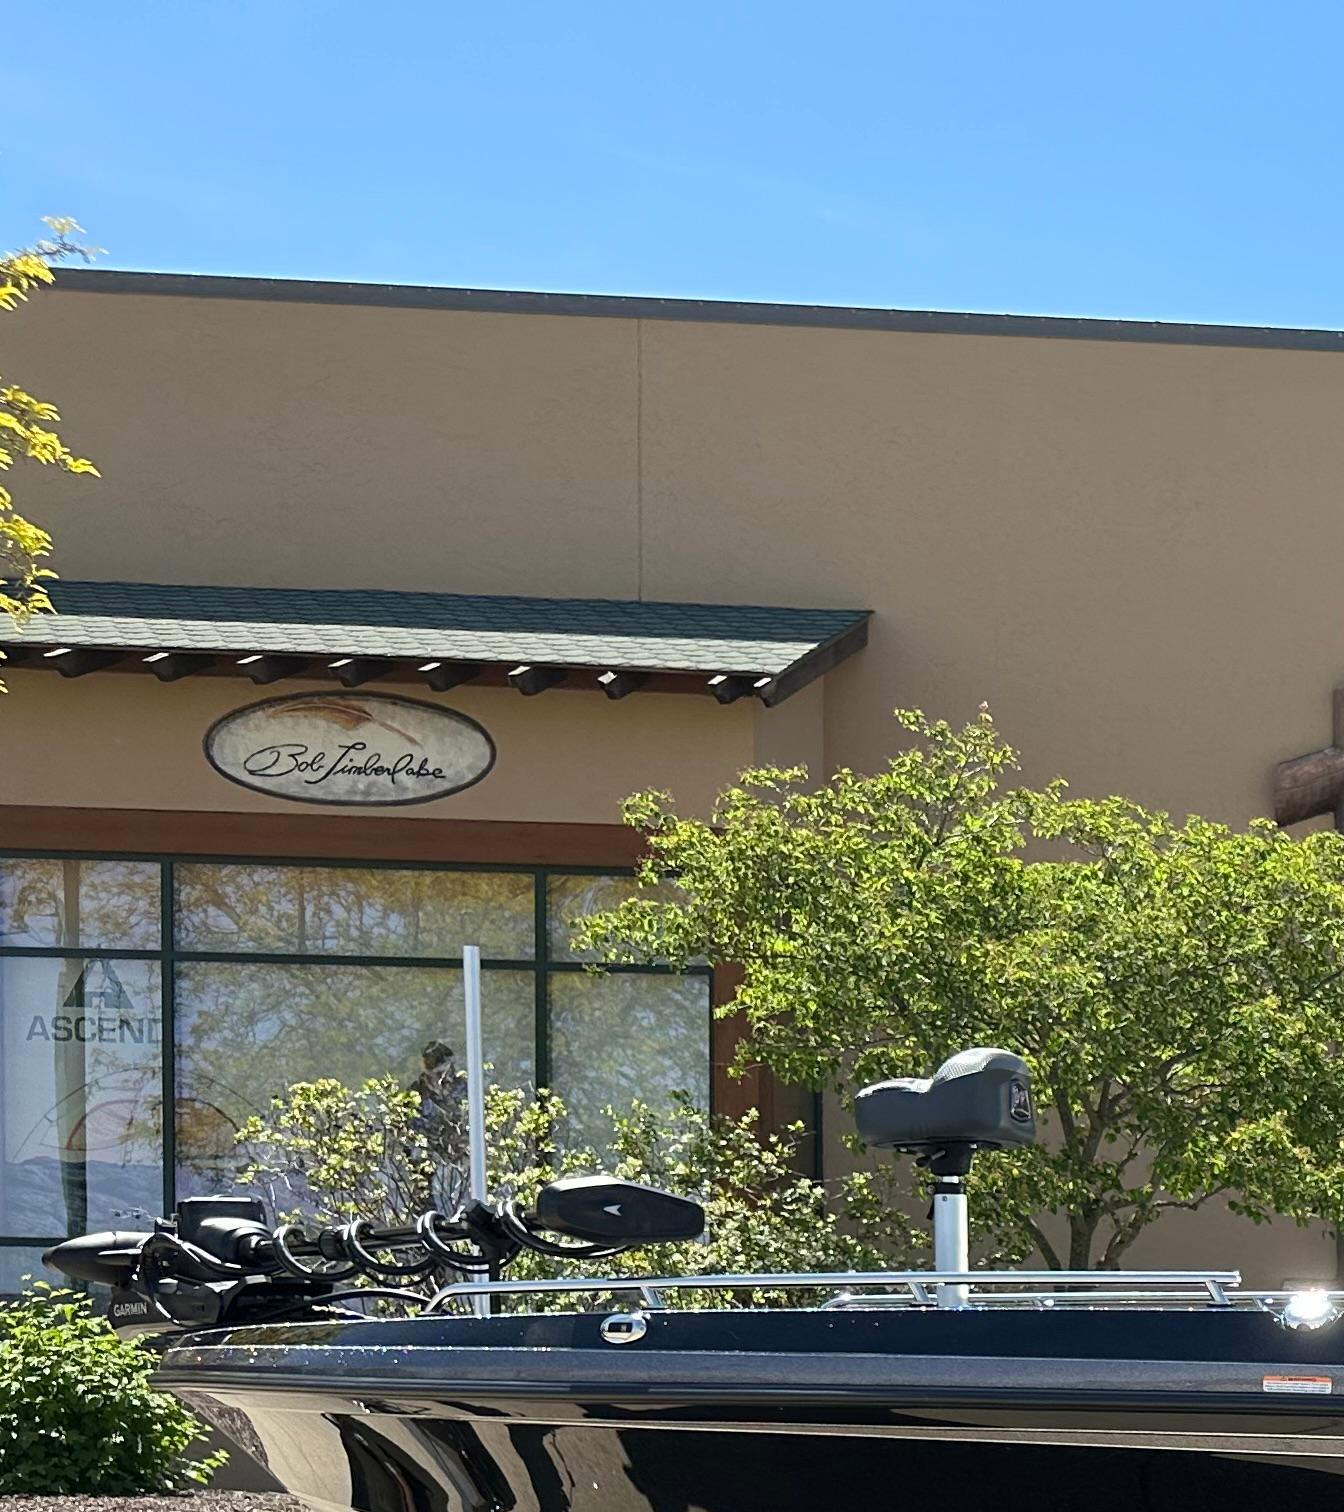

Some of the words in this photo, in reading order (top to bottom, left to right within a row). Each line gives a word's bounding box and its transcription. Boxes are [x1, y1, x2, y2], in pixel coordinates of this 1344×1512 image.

[244, 743, 325, 777] Bob
[304, 742, 447, 784] Timberlake
[113, 1302, 148, 1317] GARMIN
